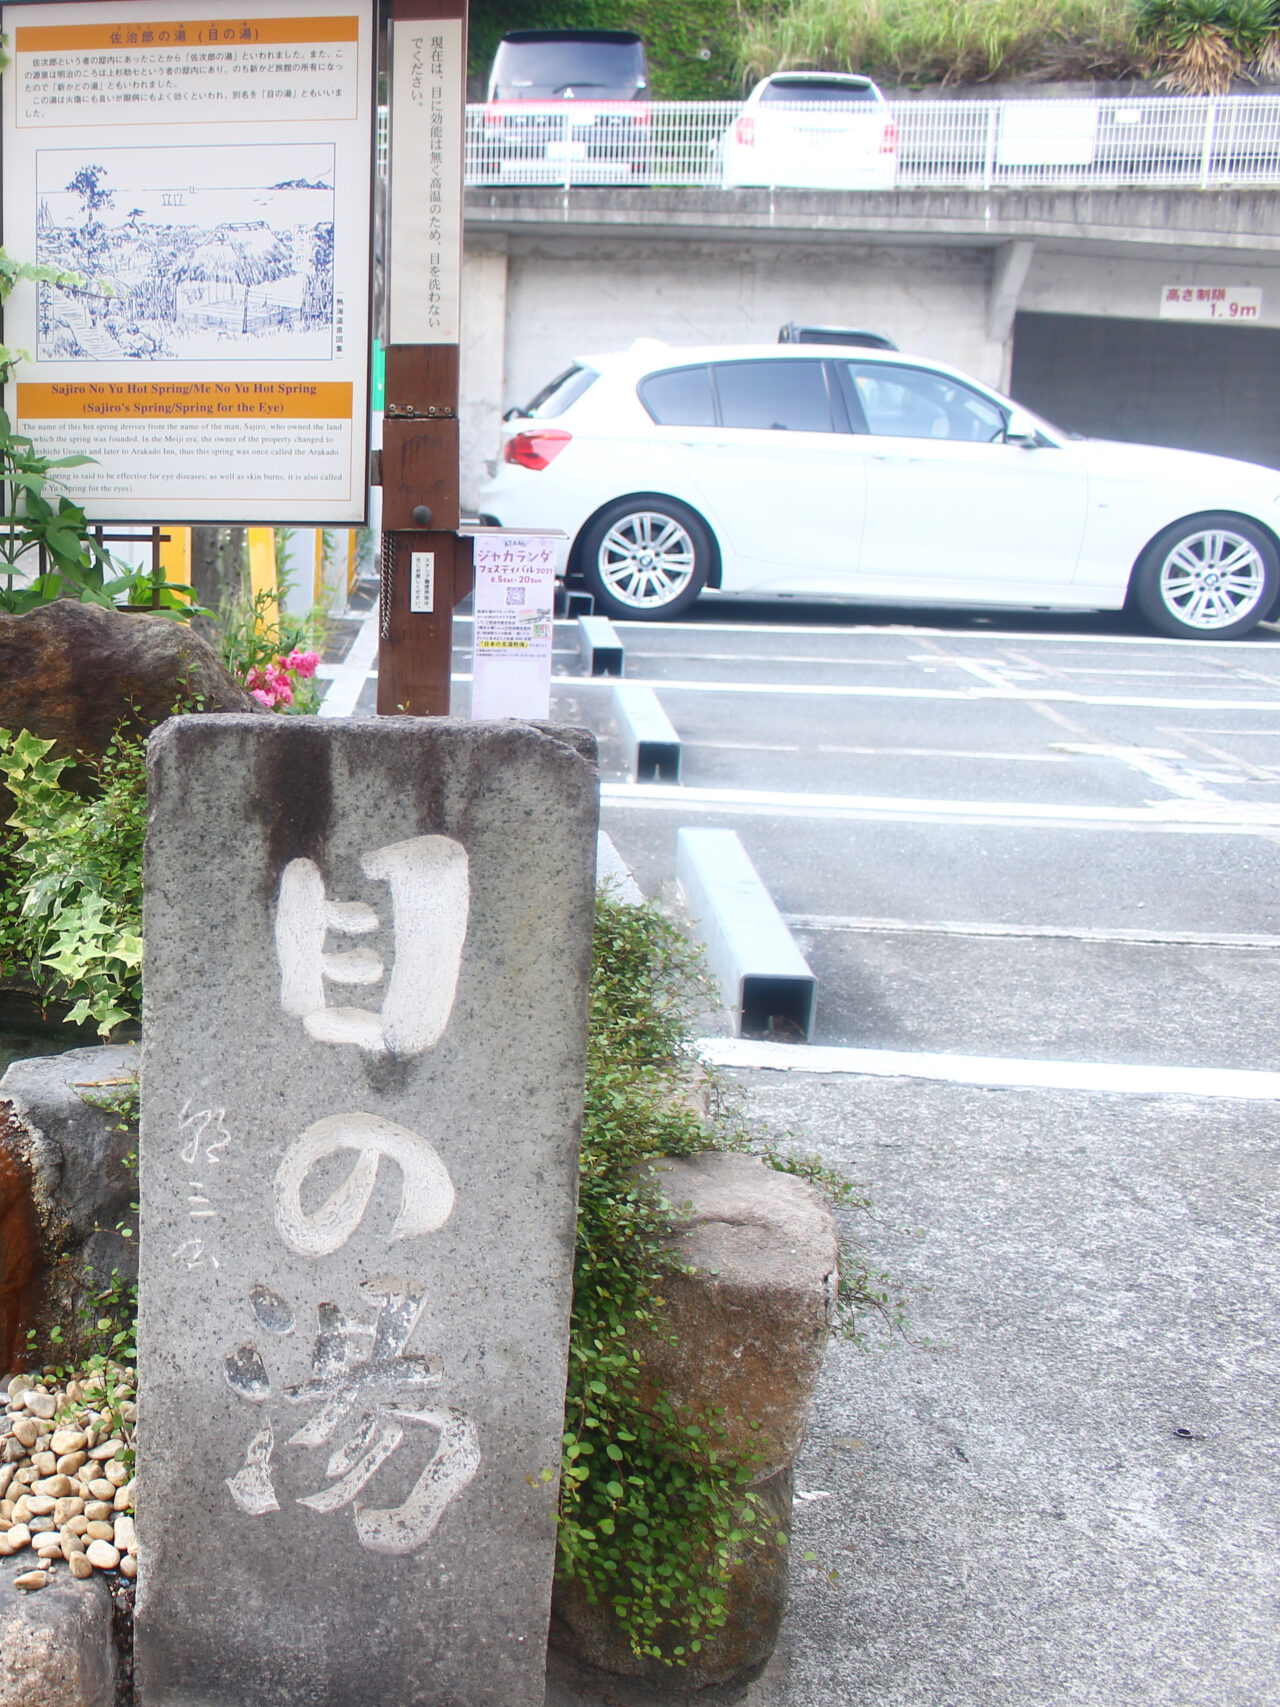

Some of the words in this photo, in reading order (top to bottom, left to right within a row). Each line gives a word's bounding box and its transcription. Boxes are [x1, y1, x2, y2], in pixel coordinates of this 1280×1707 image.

[411, 37, 424, 106] でください。
[1166, 288, 1226, 302] 高さ制限
[52, 384, 85, 396] Sajiro
[90, 384, 104, 394] No
[108, 384, 123, 394] Yu
[127, 384, 147, 394] Hot
[151, 384, 211, 396] Spring/Me
[215, 384, 230, 393] No
[235, 384, 249, 393] Yu
[254, 384, 274, 393] Hot
[278, 384, 317, 395] Spring
[83, 403, 130, 414] (Sajiro's
[134, 403, 213, 414] Spring/Spring
[217, 403, 232, 412] for
[237, 403, 254, 412] the
[259, 403, 284, 414] Eye)
[96, 423, 118, 432] spring
[244, 423, 267, 432] Sajiro,
[69, 435, 91, 444] spring
[164, 436, 184, 444] Meiji
[261, 436, 292, 444] property
[294, 436, 324, 444] changed
[163, 448, 177, 457] Inn,
[211, 448, 233, 457] spring
[176, 472, 207, 482] diseases,
[263, 473, 285, 482] burns,
[478, 550, 552, 563] ジャカランダ
[479, 565, 534, 573] フェスティバル
[224, 833, 482, 1556] 目の湯
